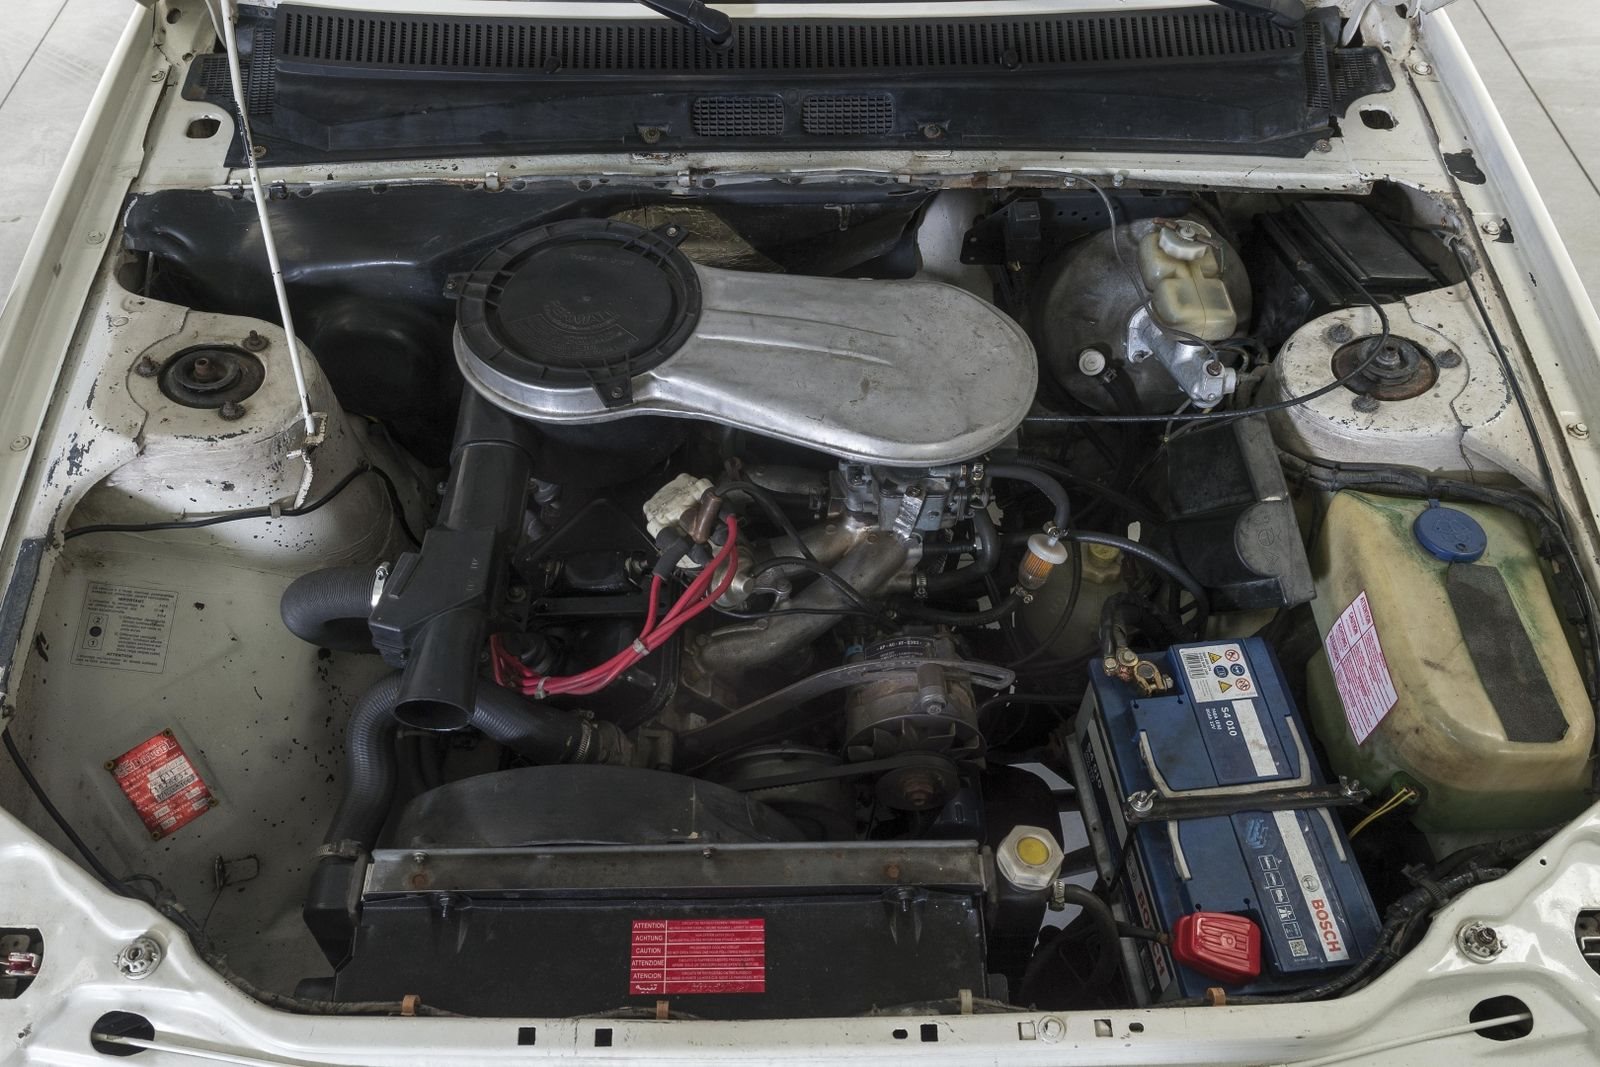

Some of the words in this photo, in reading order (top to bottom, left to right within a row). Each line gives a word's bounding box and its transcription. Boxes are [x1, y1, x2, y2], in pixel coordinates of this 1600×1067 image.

[1359, 596, 1372, 625] ATTENTION
[1348, 611, 1358, 635] CAUTION
[1220, 706, 1231, 718] S4
[1225, 719, 1237, 736] 010
[1136, 890, 1166, 975] BOCH
[1311, 899, 1341, 953] BOSCH
[632, 959, 664, 967] ATTENZIONE
